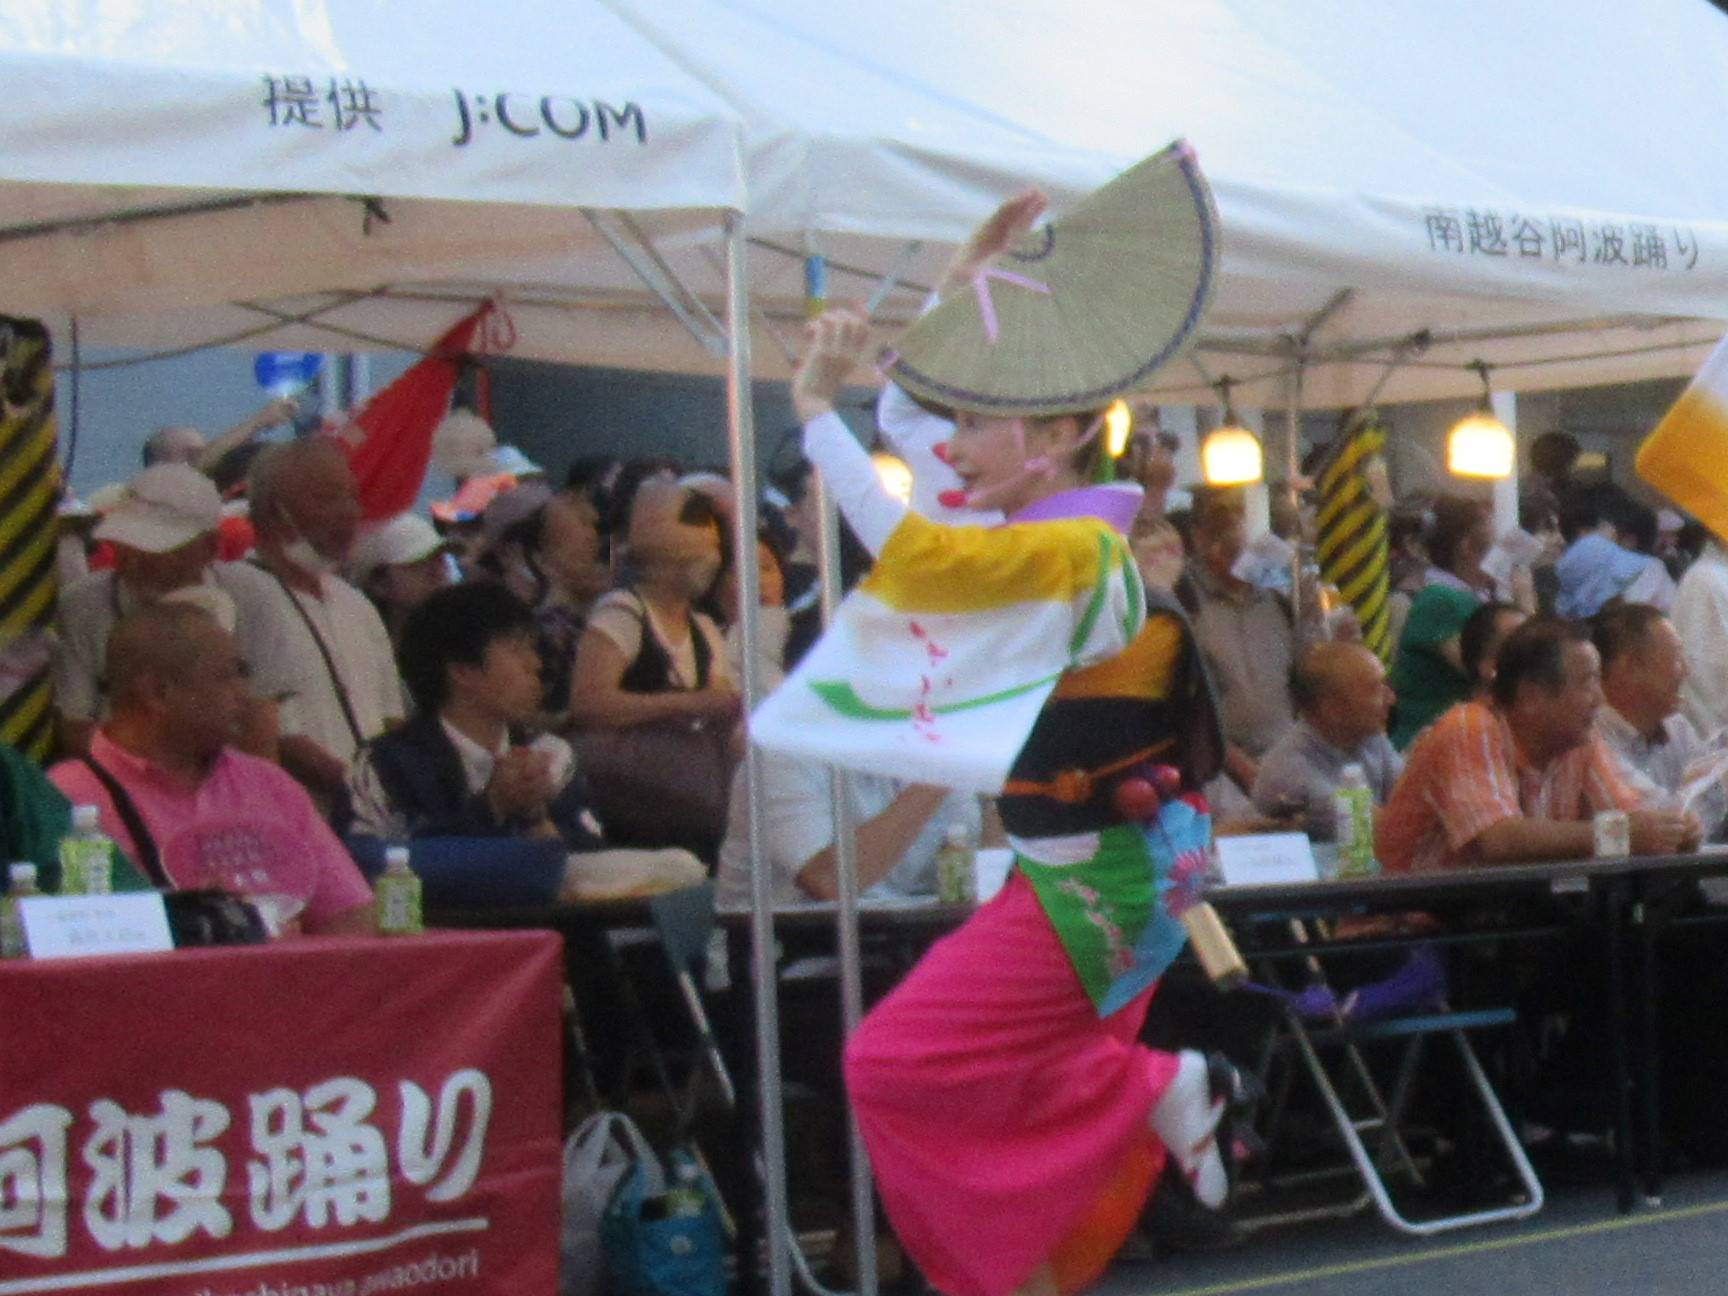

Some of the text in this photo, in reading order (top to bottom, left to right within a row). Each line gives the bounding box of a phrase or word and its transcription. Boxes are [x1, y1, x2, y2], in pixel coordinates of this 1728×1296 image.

[262, 72, 648, 146] 提供 J:COM
[1423, 207, 1700, 271] 南越谷阿波踊り
